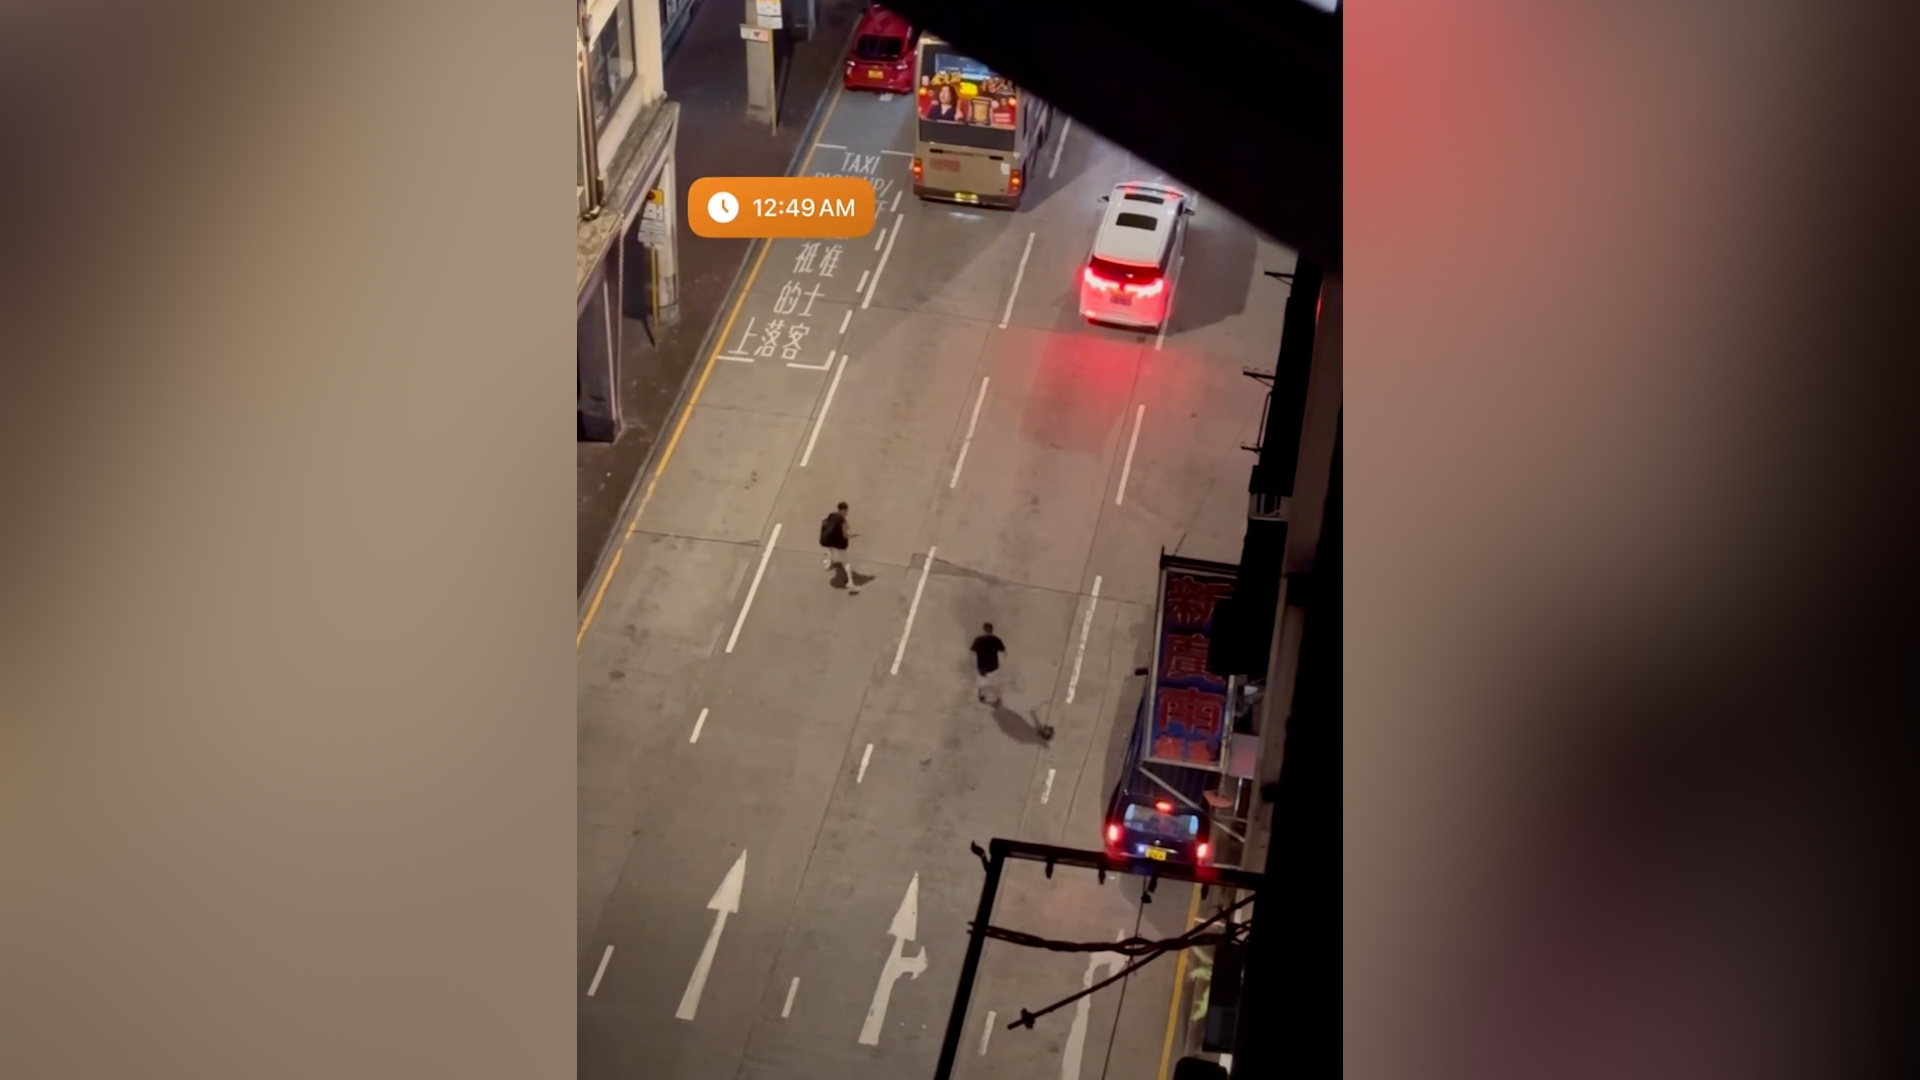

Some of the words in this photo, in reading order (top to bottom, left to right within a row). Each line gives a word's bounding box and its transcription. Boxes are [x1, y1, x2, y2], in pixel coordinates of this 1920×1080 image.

[840, 152, 880, 175] TAXI
[773, 280, 825, 316] 的士
[728, 317, 810, 360] 上落客
